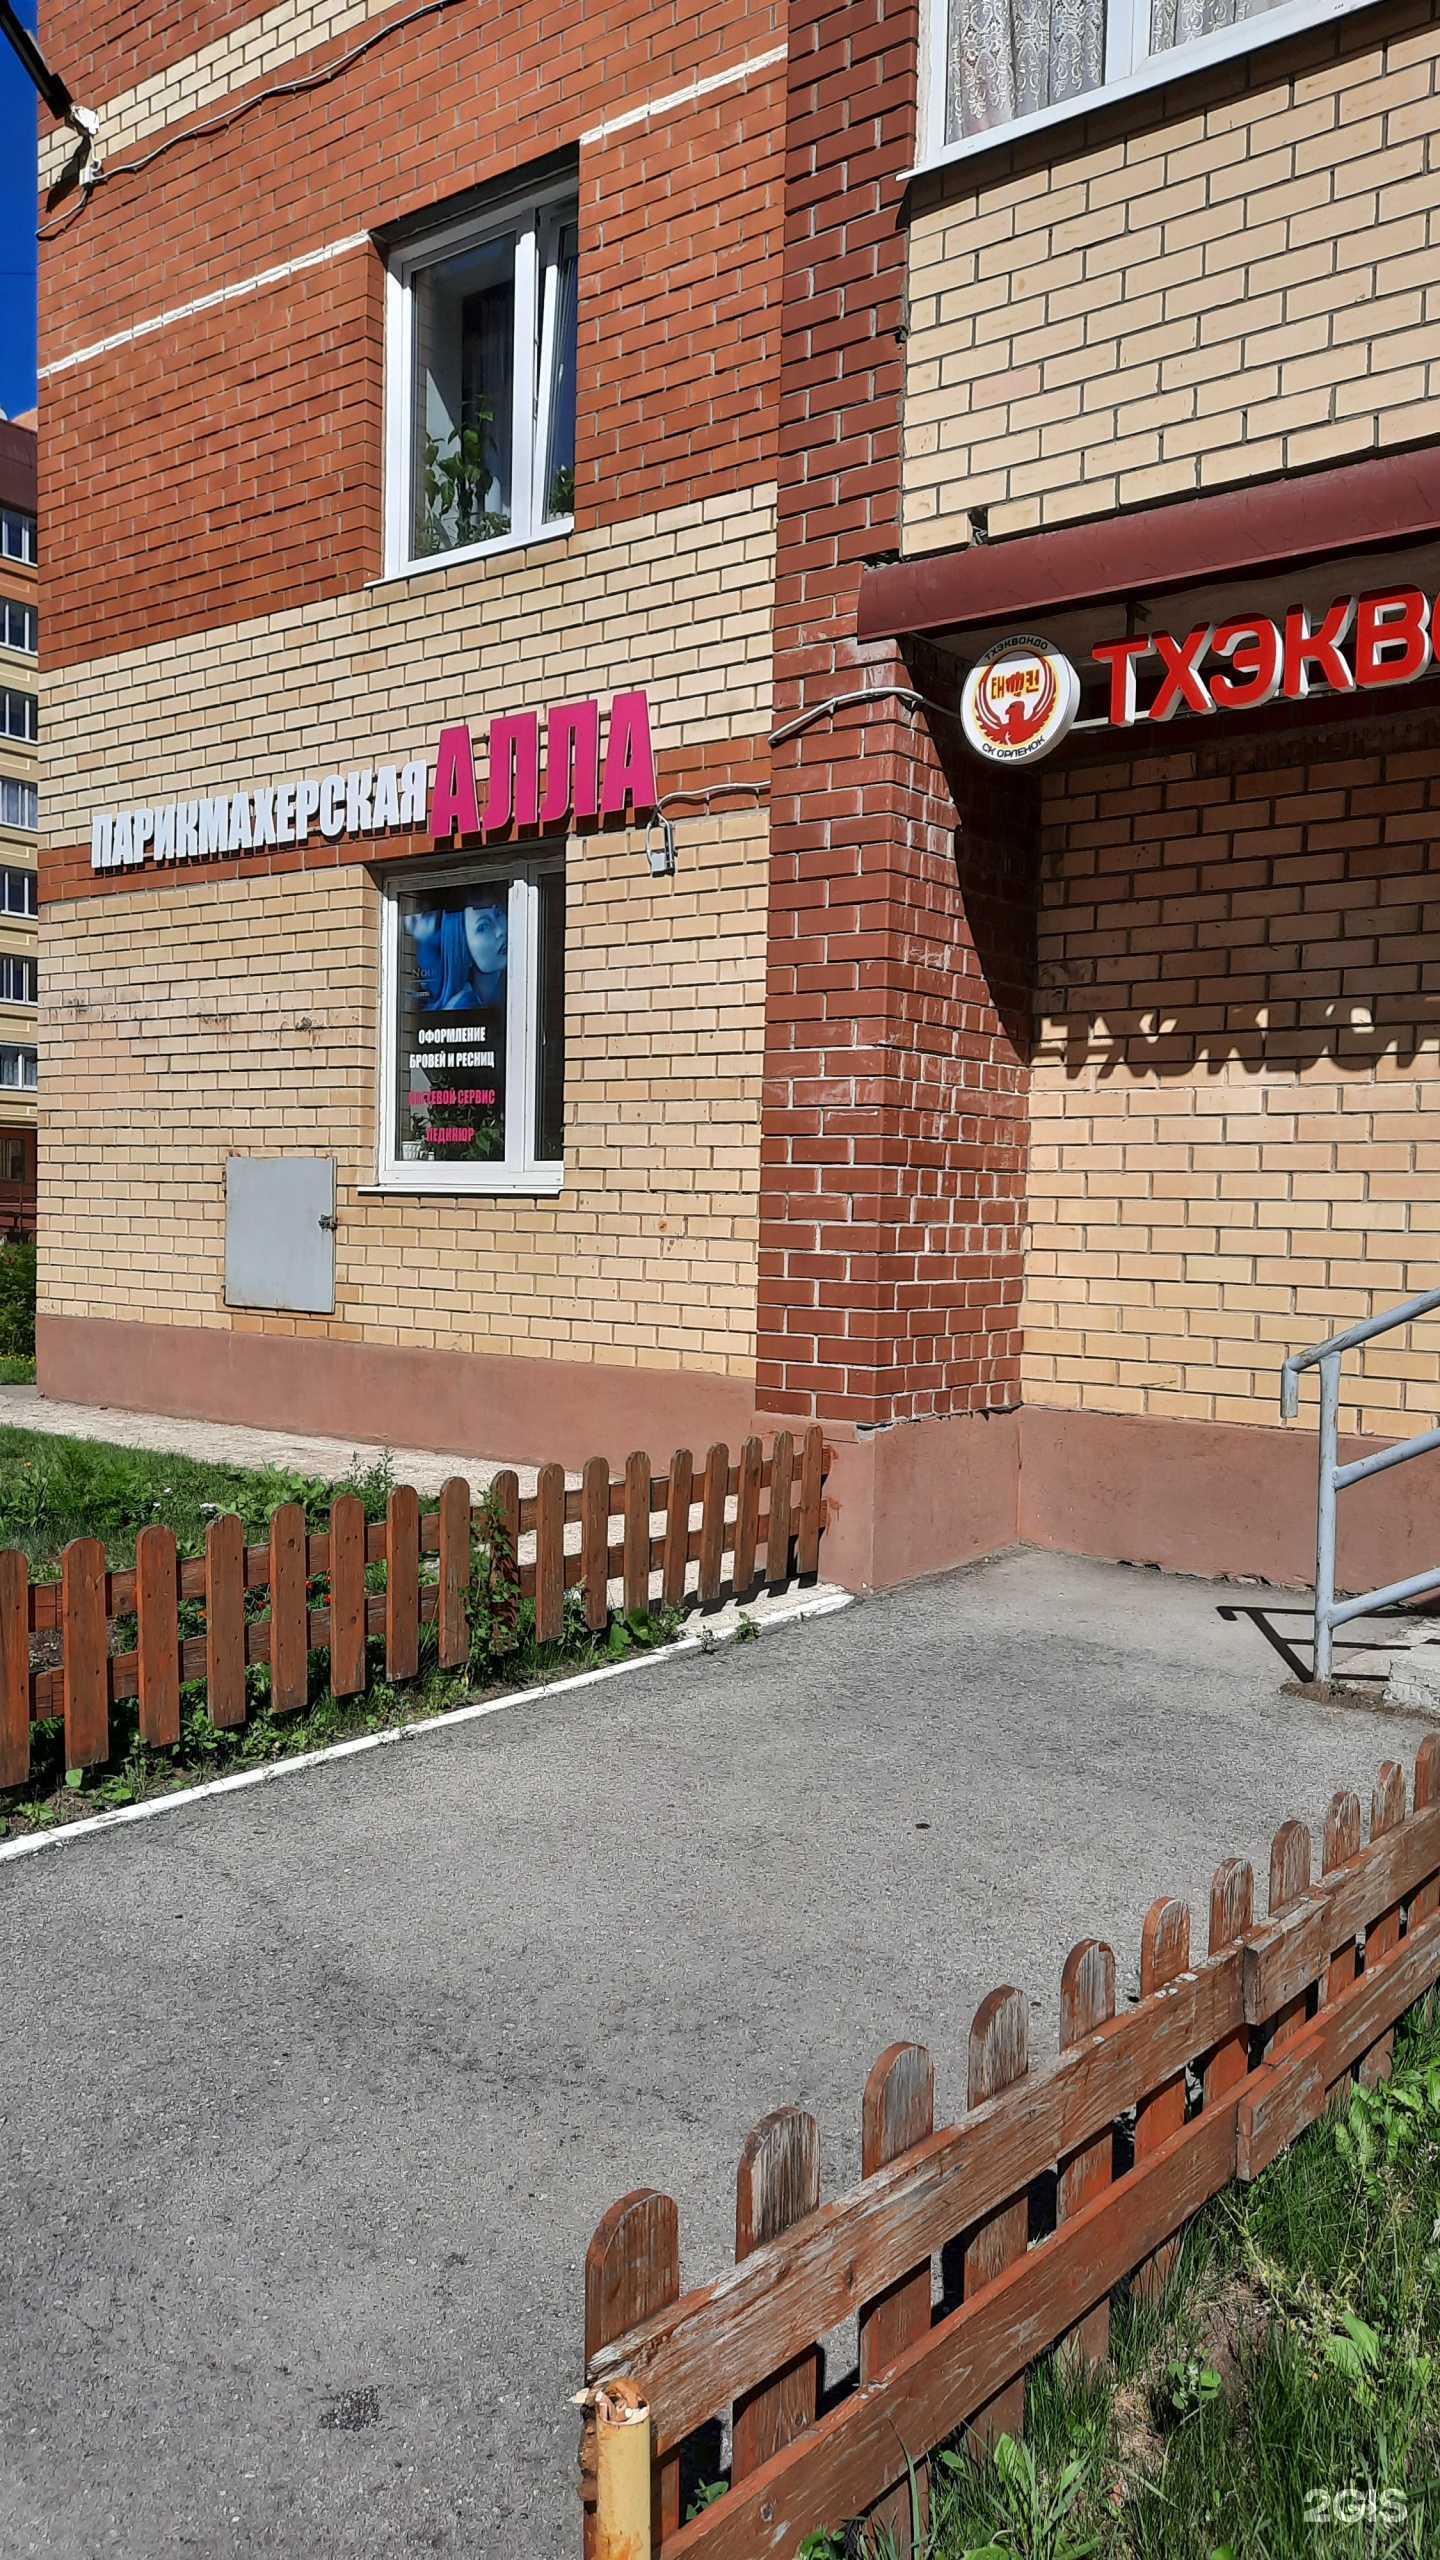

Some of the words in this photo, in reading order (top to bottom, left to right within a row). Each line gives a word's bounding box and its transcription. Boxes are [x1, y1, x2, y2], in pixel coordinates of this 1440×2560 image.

[984, 636, 1048, 660] ТХЭКВОНДО
[1092, 583, 1440, 727] ТХЭКВ
[982, 743, 995, 756] СК
[997, 736, 1046, 758] ОРЛЕНОК
[91, 759, 428, 869] ПАРИКМАХЕРСКАЯ
[429, 689, 658, 838] АЛЛА
[418, 1026, 486, 1044] ОФОРМЛЕНИЕ
[409, 1050, 446, 1068] БРОВЕЙ
[447, 1053, 455, 1067] И
[456, 1051, 495, 1068] РЕСНИЦ
[457, 1089, 496, 1105] СЕРВИС
